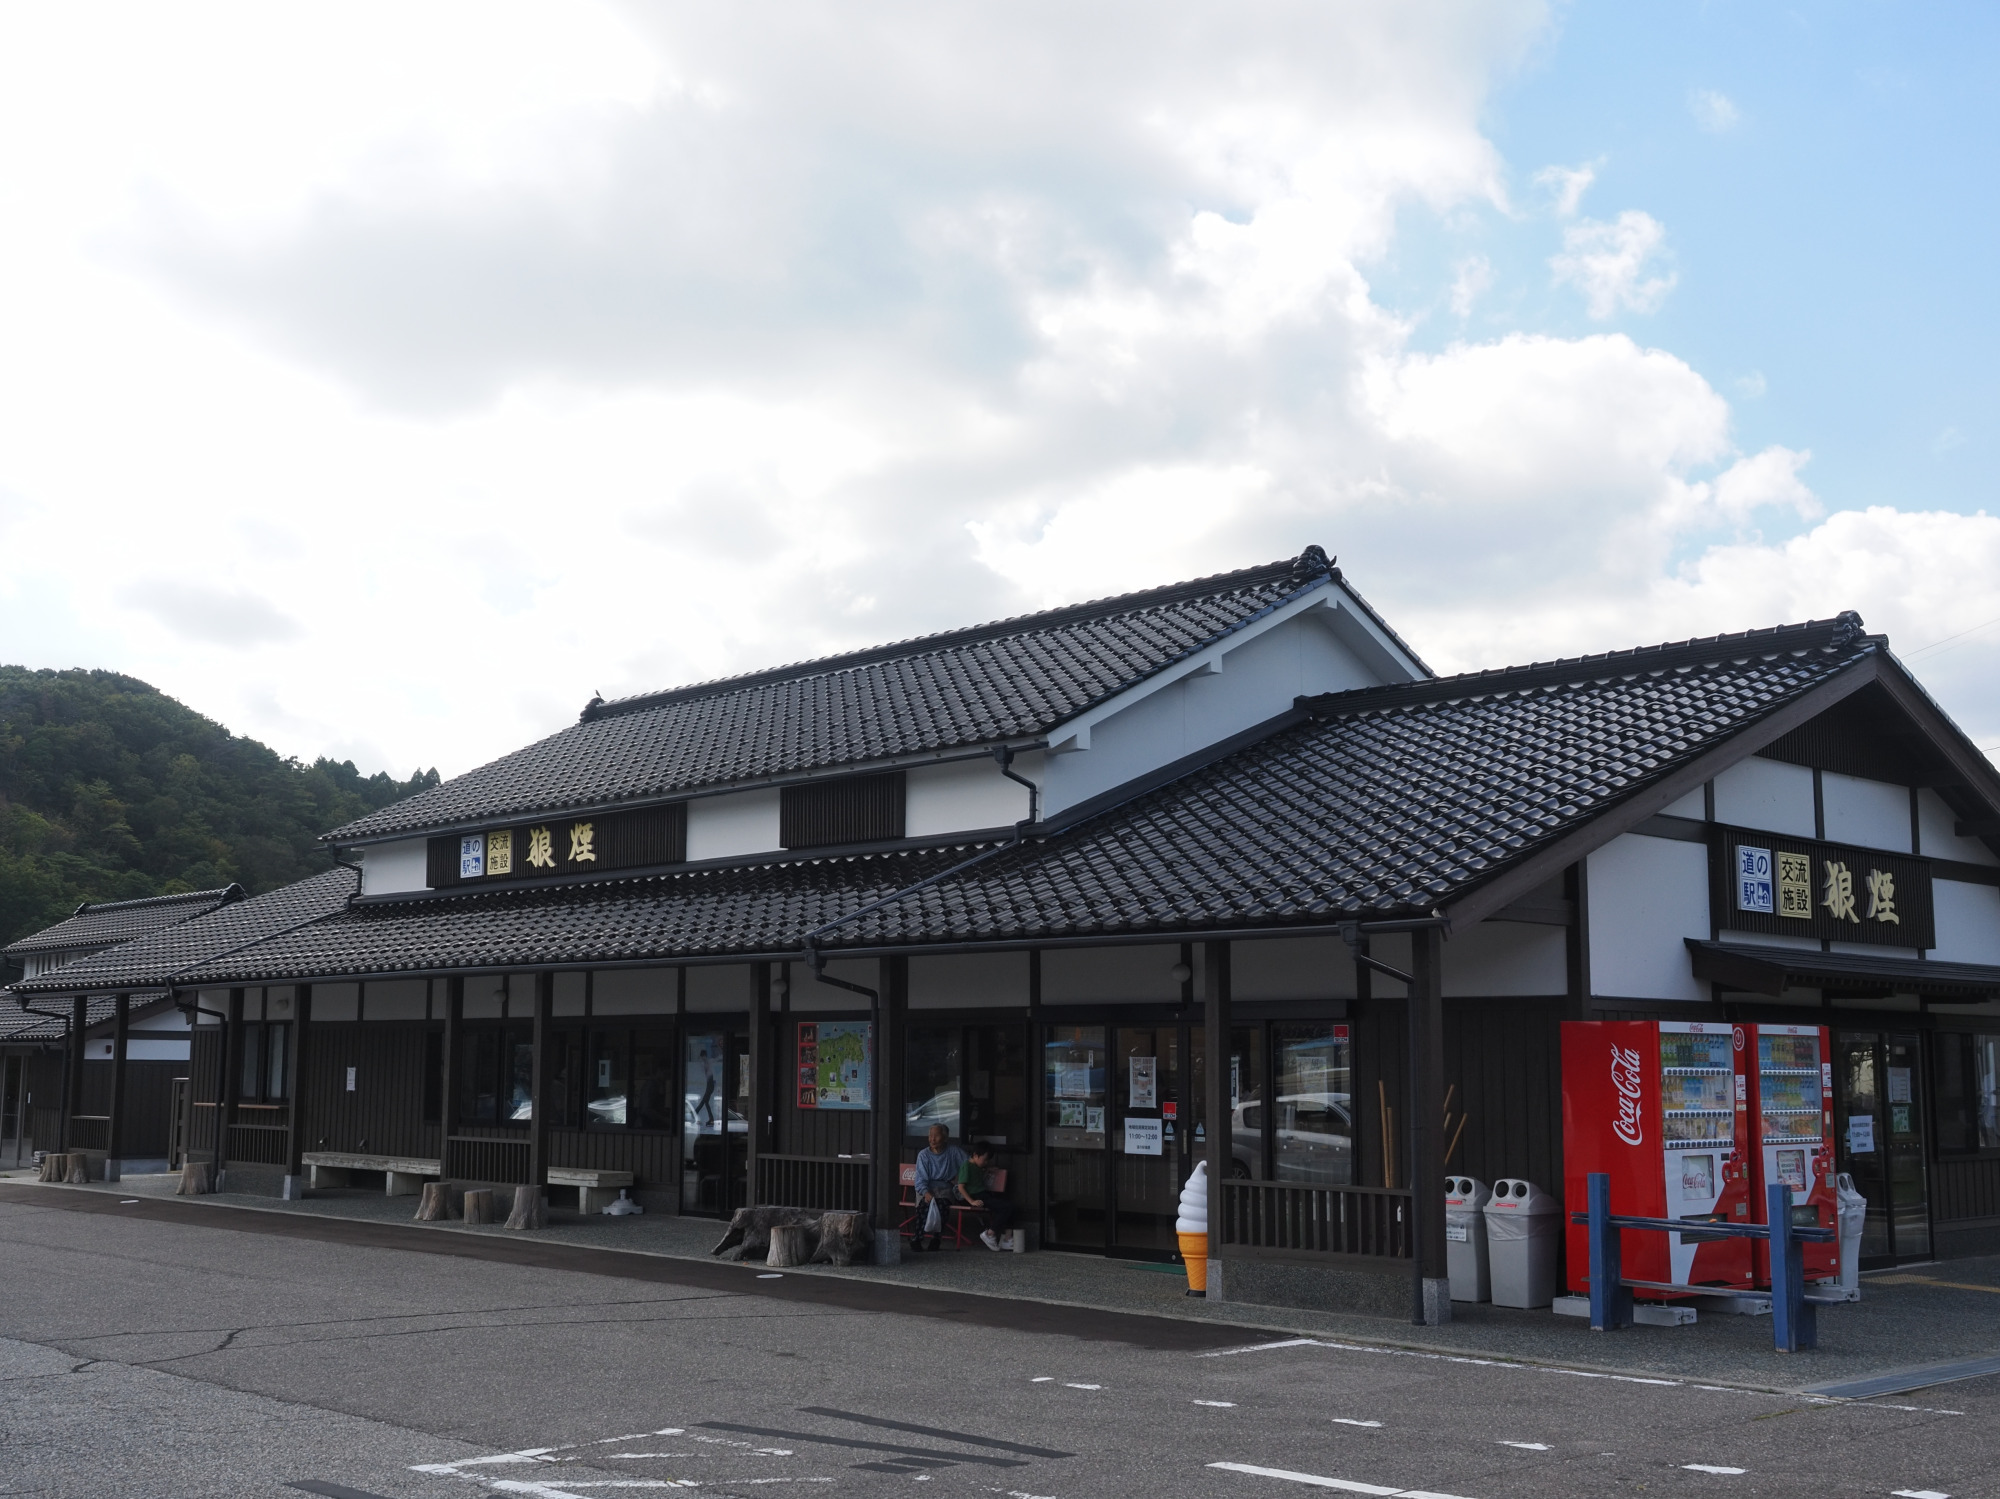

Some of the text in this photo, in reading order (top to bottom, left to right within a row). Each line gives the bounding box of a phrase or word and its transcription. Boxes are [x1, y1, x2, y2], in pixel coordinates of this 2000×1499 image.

[462, 839, 481, 855] 道の
[490, 834, 509, 851] 交流
[526, 822, 597, 868] 狼煙
[462, 859, 471, 875] 駅
[489, 853, 509, 870] 施設
[1742, 851, 1768, 876] 道の
[1781, 858, 1808, 884] 交流
[1743, 881, 1756, 906] 駅
[1782, 886, 1809, 912] 施設
[1819, 859, 1900, 926] 狼煙
